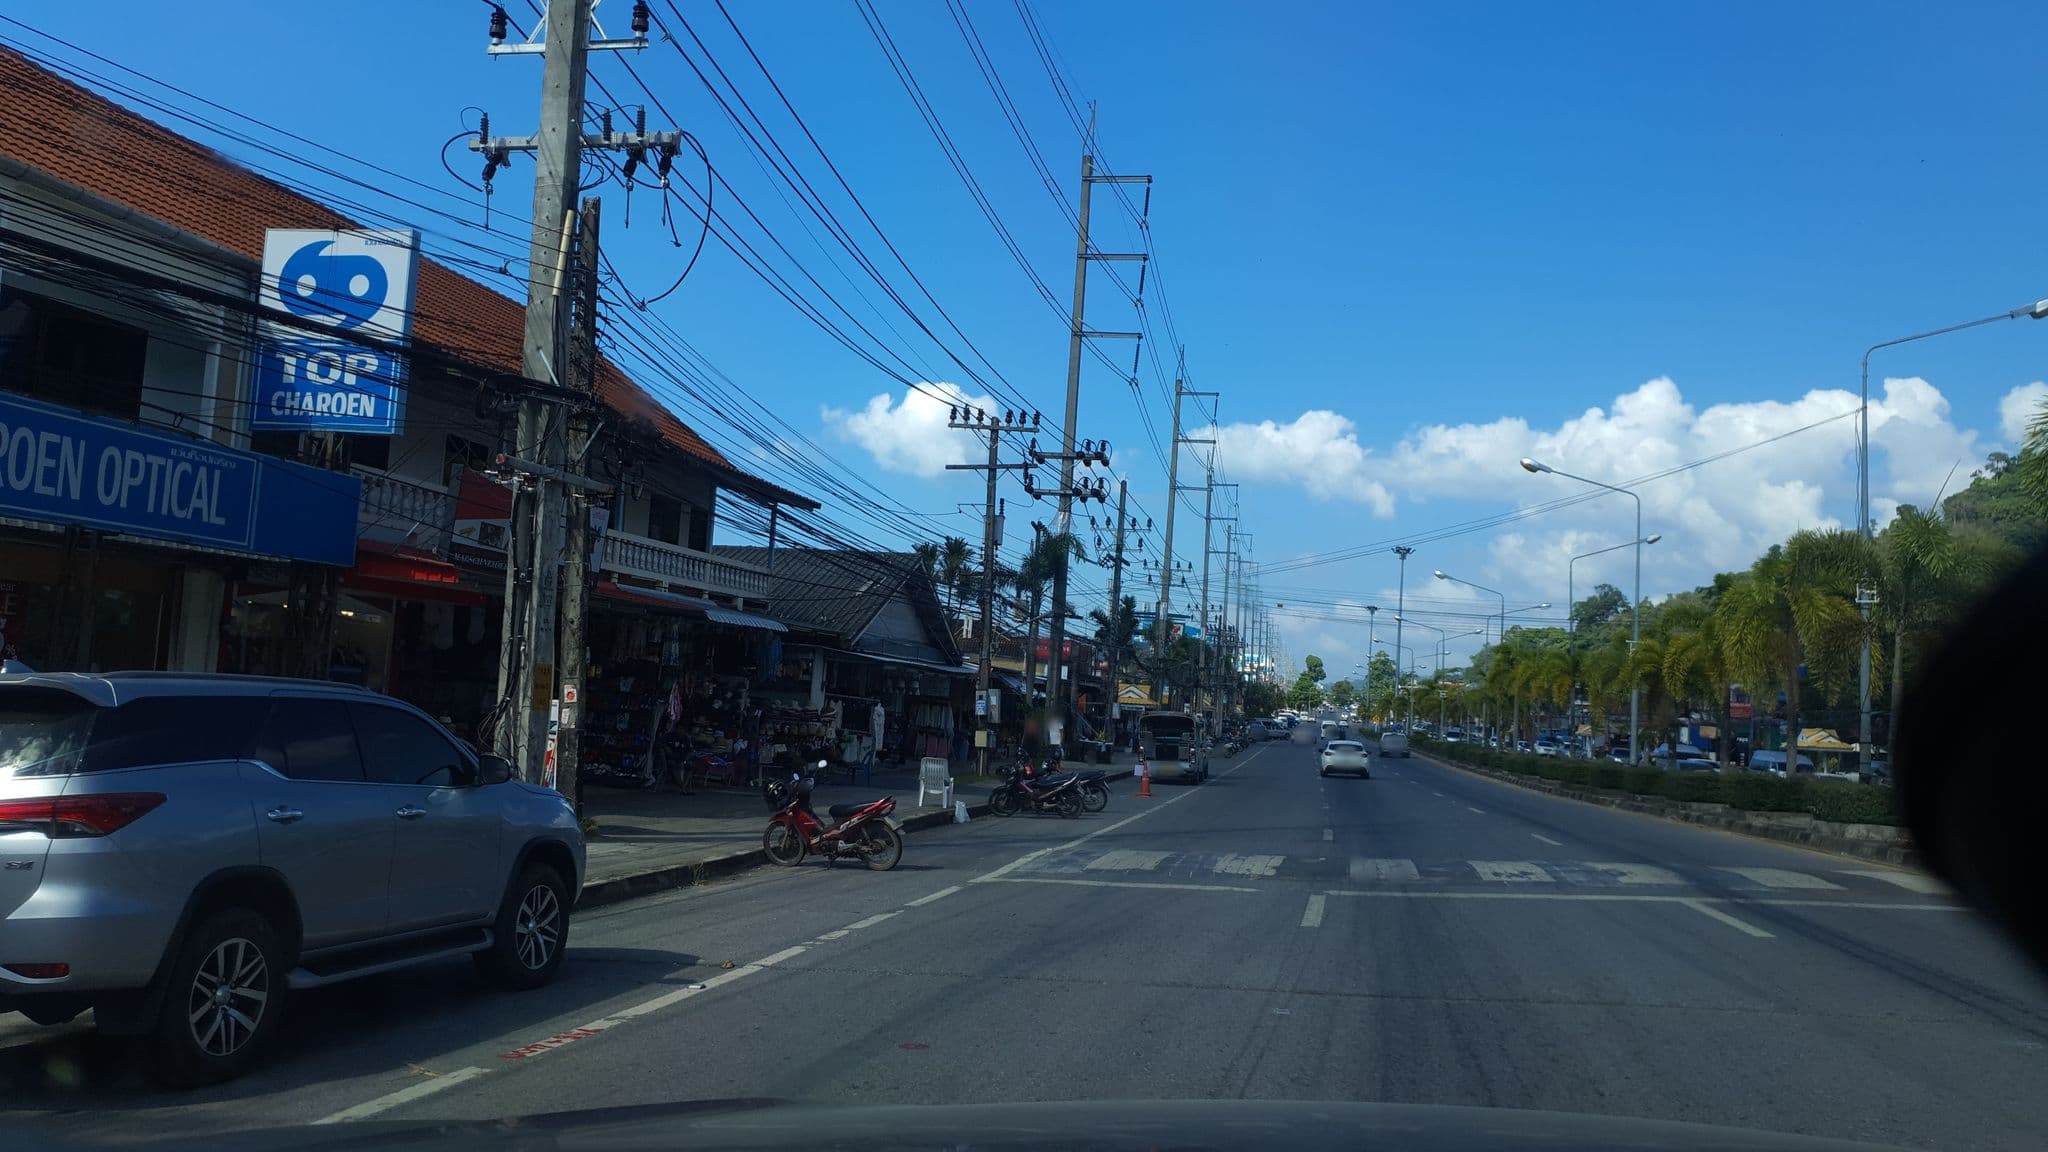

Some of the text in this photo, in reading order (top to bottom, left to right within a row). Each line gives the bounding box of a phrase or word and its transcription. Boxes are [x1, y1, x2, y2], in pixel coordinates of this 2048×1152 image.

[276, 351, 379, 385] TOP
[271, 391, 376, 418] CHAROEN
[97, 445, 226, 526] OPTICAL
